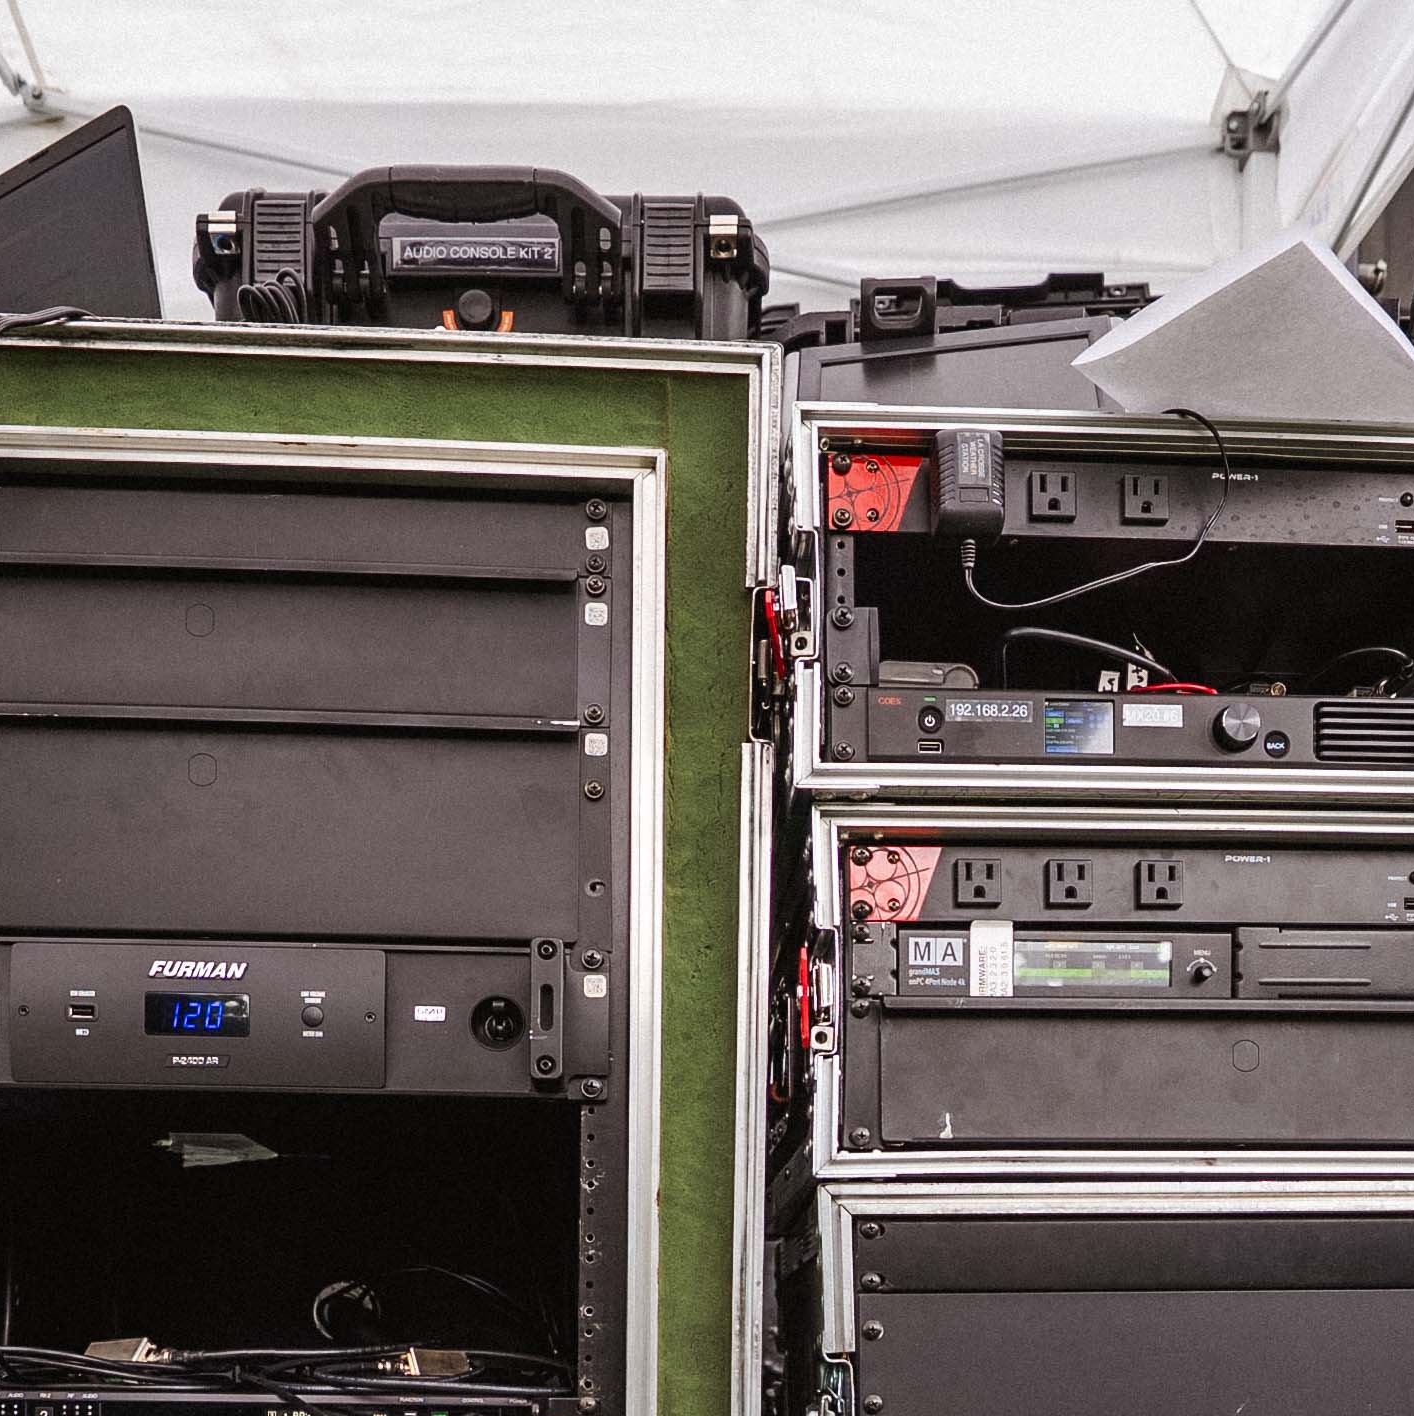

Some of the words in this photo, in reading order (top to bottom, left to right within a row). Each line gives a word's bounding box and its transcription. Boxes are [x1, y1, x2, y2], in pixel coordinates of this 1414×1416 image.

[403, 244, 449, 259] AUDIO
[447, 244, 516, 258] CONSOLE
[519, 244, 541, 259] KIT
[541, 244, 554, 260] 2
[950, 704, 1027, 720] 192.168.2.26
[1225, 855, 1270, 863] POWER-1
[149, 961, 247, 979] FURMAN
[909, 968, 940, 977] grandMA3
[909, 977, 924, 985] onPC
[173, 1001, 224, 1029] 120
